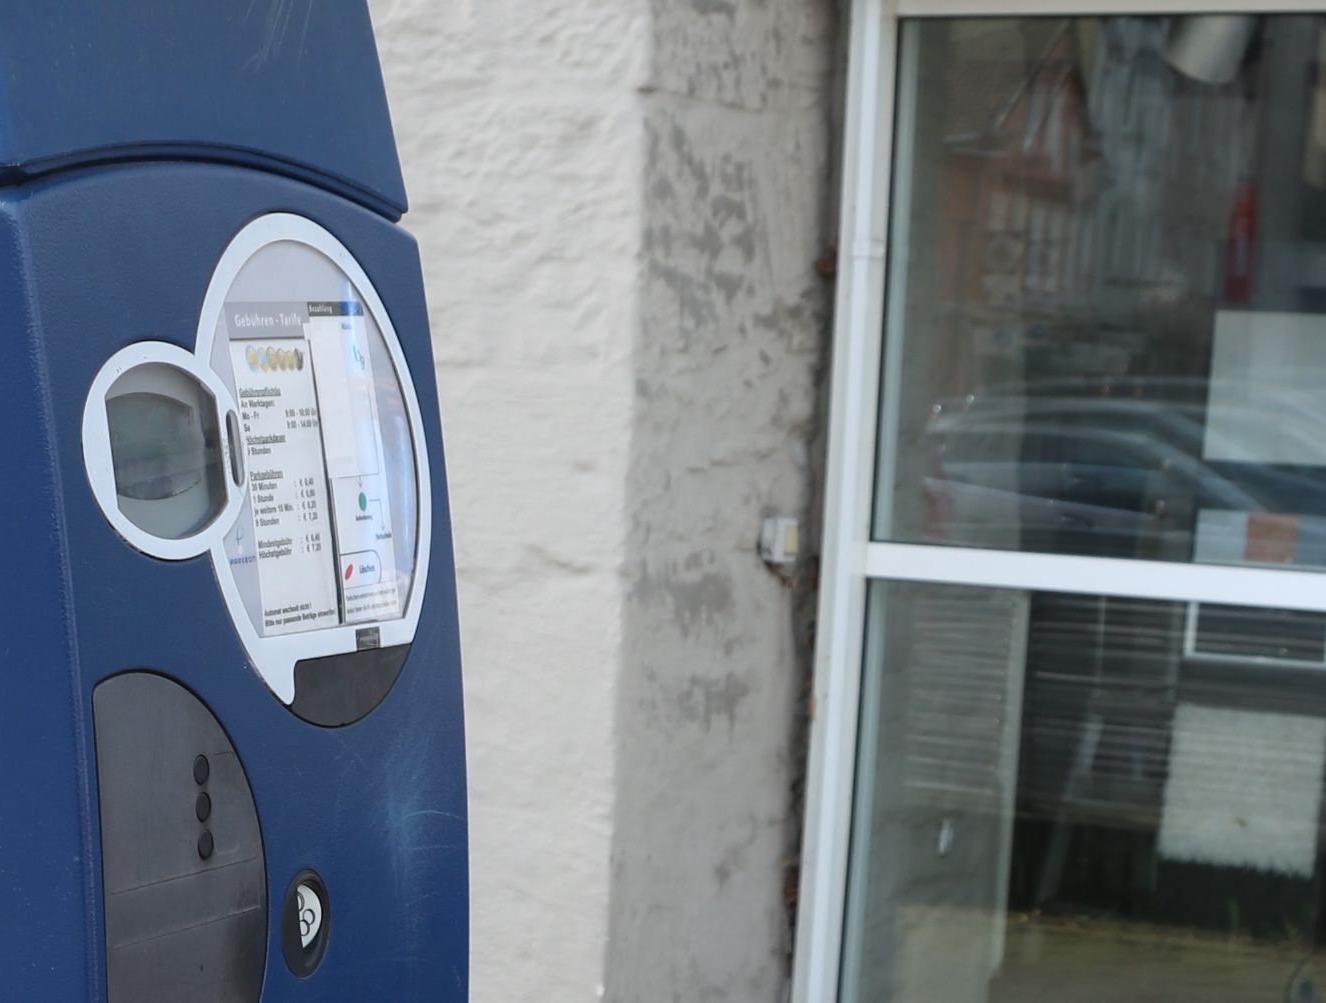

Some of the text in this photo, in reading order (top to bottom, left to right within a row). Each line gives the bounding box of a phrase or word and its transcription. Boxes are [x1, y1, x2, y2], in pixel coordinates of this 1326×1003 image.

[308, 304, 333, 314] Bezahlung
[234, 313, 274, 327] Gebühren
[279, 313, 301, 326] Tarife
[242, 412, 250, 420] Mo
[254, 411, 259, 419] Fr
[243, 424, 250, 432] Sa
[251, 446, 272, 455] Stunden
[258, 481, 278, 491] Minuten
[257, 493, 274, 503] Stunde
[259, 517, 280, 527] Stunden
[257, 537, 293, 549] Mindestgebühr
[258, 548, 292, 559] Höchstgebühr
[264, 608, 282, 617] Automat
